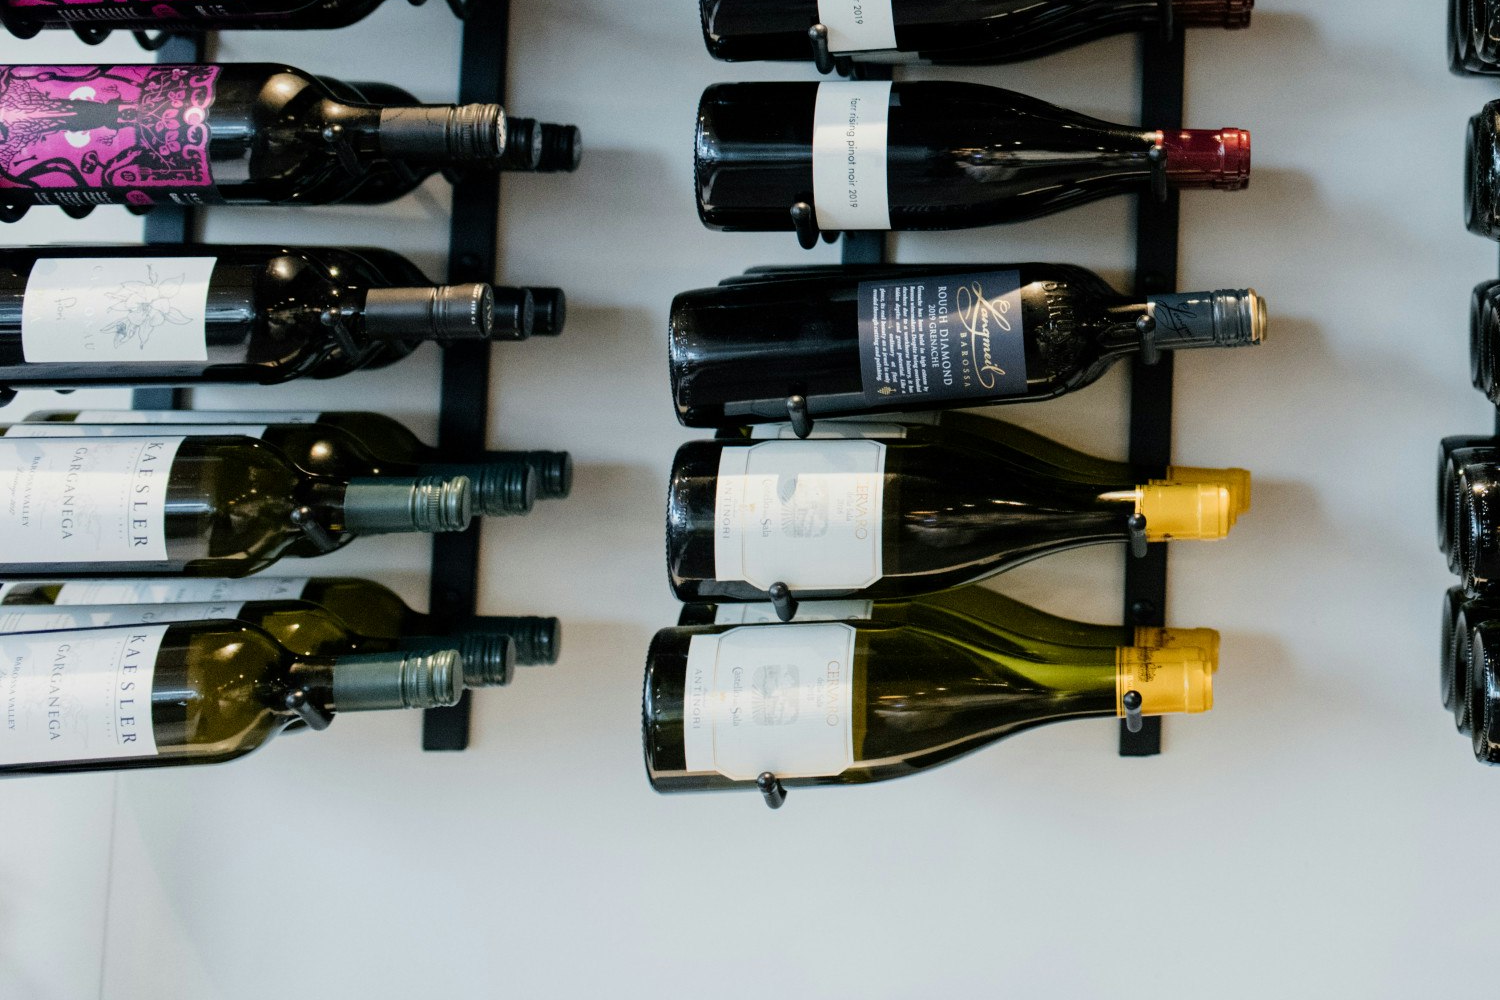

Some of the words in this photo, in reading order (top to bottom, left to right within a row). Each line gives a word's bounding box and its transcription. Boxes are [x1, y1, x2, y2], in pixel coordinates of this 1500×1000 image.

[853, 5, 863, 25] 2019
[846, 113, 858, 137] rising
[850, 98, 860, 111] farr
[846, 140, 857, 165] pinot
[848, 168, 858, 186] noir
[848, 189, 858, 208] 2019
[928, 304, 936, 321] 2019
[938, 286, 949, 323] ROUGH
[928, 322, 940, 368] GRENACHE
[957, 281, 1011, 389] Langmeil
[939, 328, 953, 386] DIAMOND
[959, 332, 972, 387] BAROSSA
[22, 493, 32, 527] VALLEY
[61, 447, 88, 539] GARGANEGA
[133, 442, 164, 547] KAESLER
[722, 480, 733, 539] ANTINORI
[855, 474, 870, 540] ERVARO
[9, 656, 24, 694] BAROSSA
[48, 644, 71, 741] GARGANEGA
[119, 634, 147, 744] KAESLER
[826, 660, 840, 727] CERVARO
[8, 697, 16, 731] VALLEY
[692, 668, 703, 729] ANTINORI
[730, 707, 742, 727] Sala
